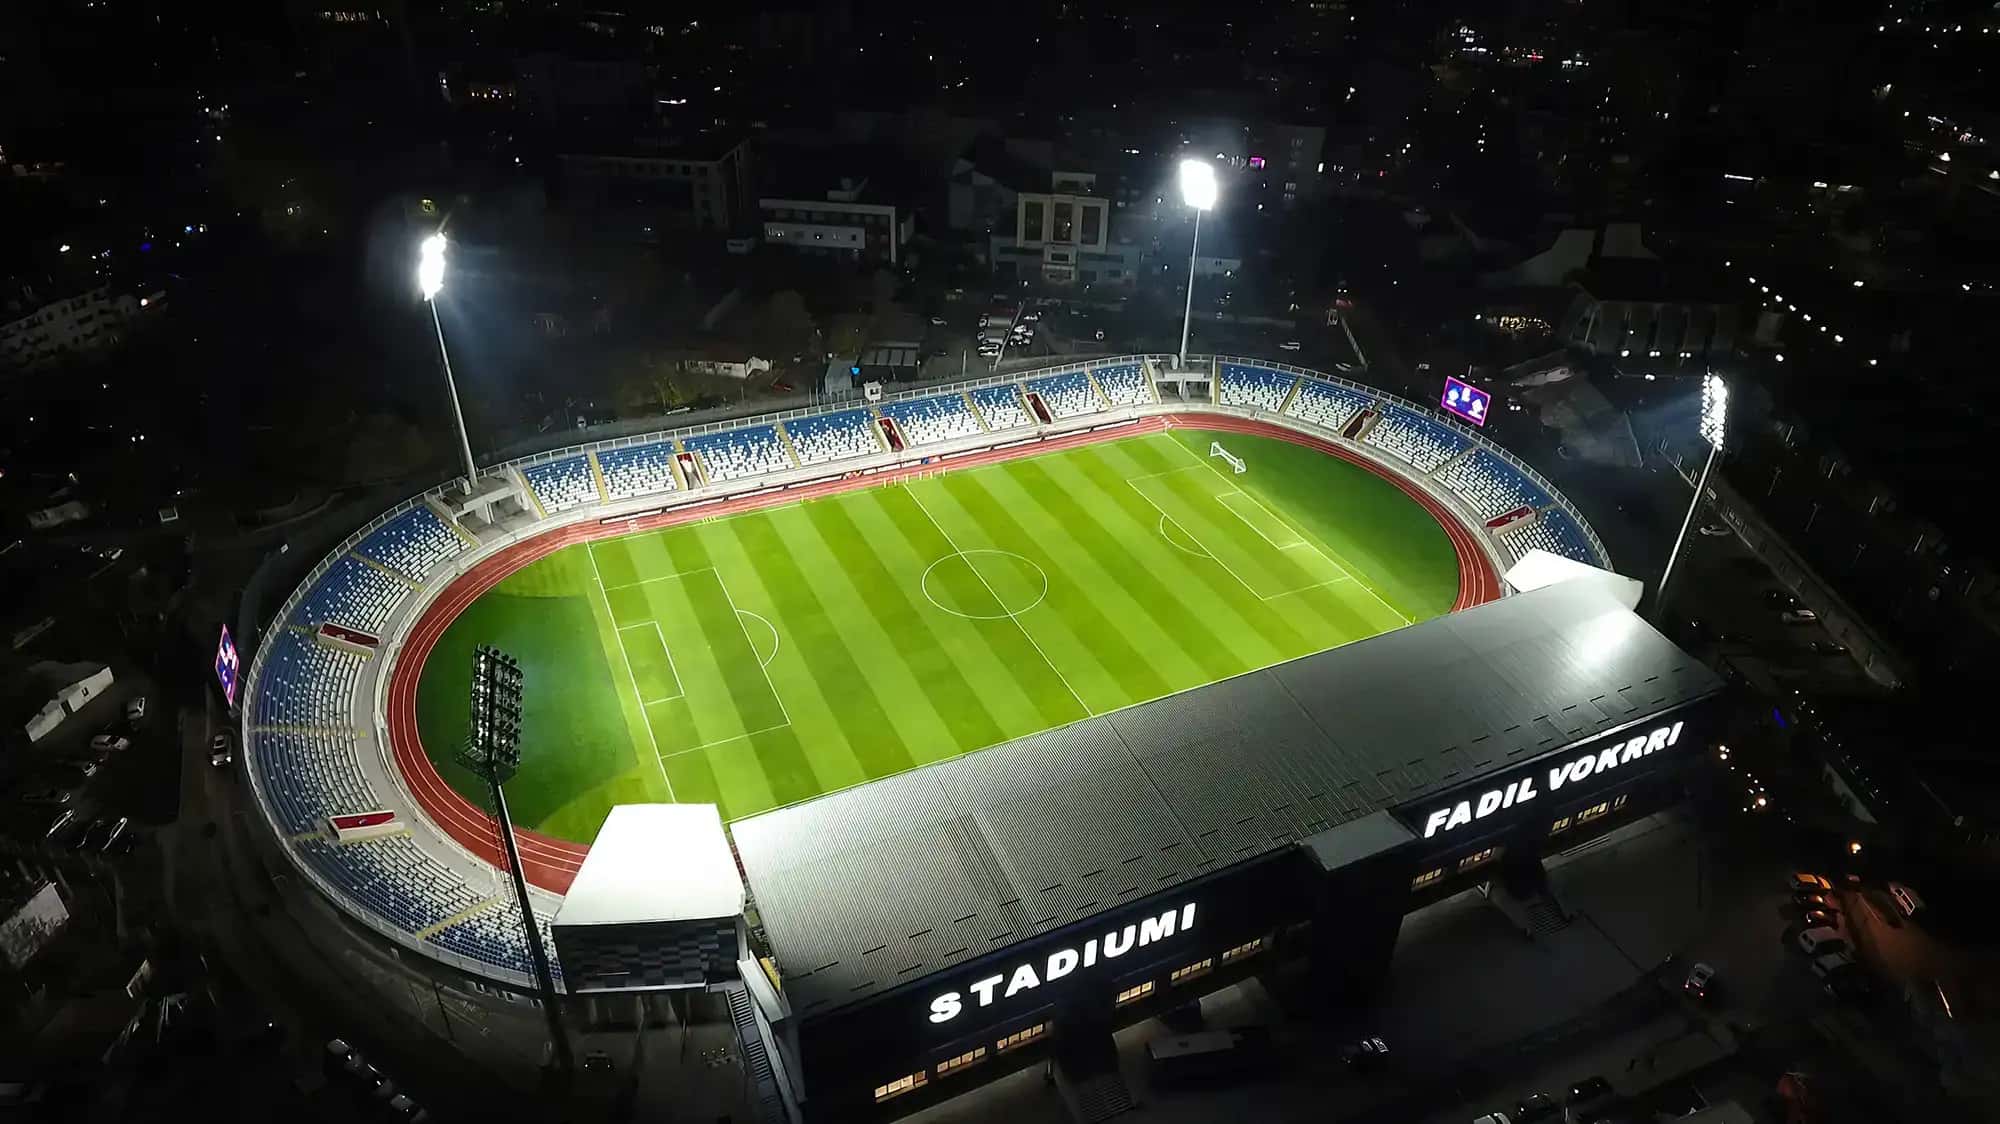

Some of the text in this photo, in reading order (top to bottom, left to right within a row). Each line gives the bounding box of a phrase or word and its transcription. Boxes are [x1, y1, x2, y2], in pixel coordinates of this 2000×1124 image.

[1424, 721, 1684, 838] FADIL VOKRRI
[929, 902, 1196, 1023] STADIUMI
